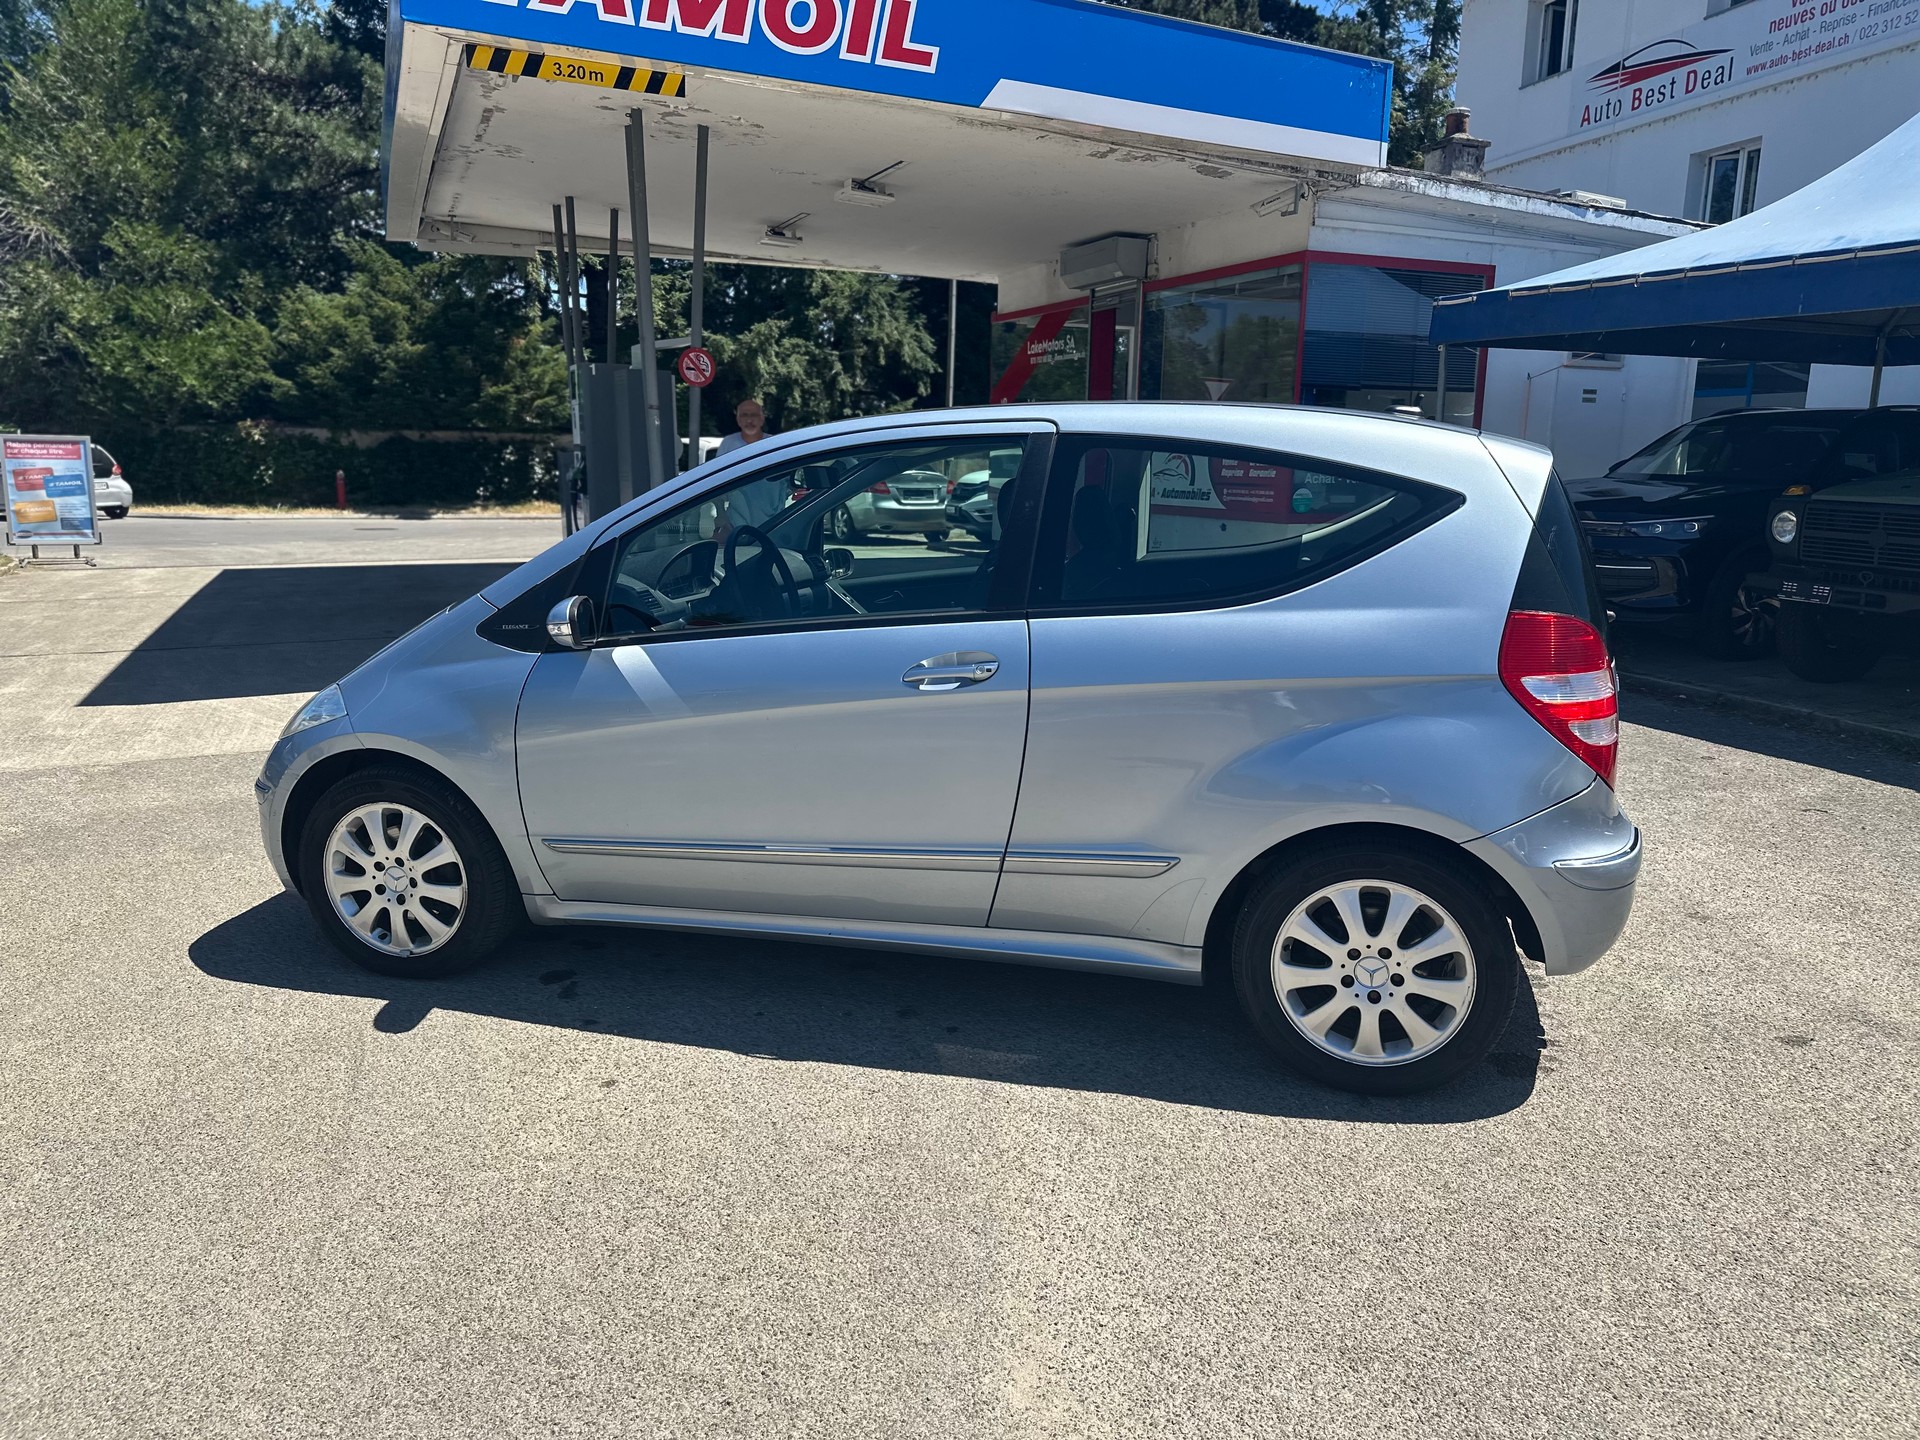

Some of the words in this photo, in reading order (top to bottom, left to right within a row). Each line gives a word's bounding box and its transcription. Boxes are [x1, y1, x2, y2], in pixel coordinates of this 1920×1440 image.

[1750, 40, 1774, 57] Vente
[1782, 27, 1810, 47] Achat
[1819, 12, 1857, 34] Reprise
[1768, 6, 1816, 34] neuves
[1820, 0, 1837, 17] ou
[483, 0, 940, 74] MOIL
[1746, 32, 1850, 76] www.auto-best-deal.ch
[1859, 22, 1879, 40] 022
[1881, 15, 1902, 34] 312
[1904, 9, 1919, 26] 52
[553, 62, 586, 80] 3.20
[588, 69, 604, 83] m
[1580, 97, 1622, 128] Auto
[1631, 76, 1676, 111] Best
[1684, 56, 1734, 95] Deal
[1027, 338, 1065, 355] LakeMotors
[1161, 487, 1211, 501] Automobiles
